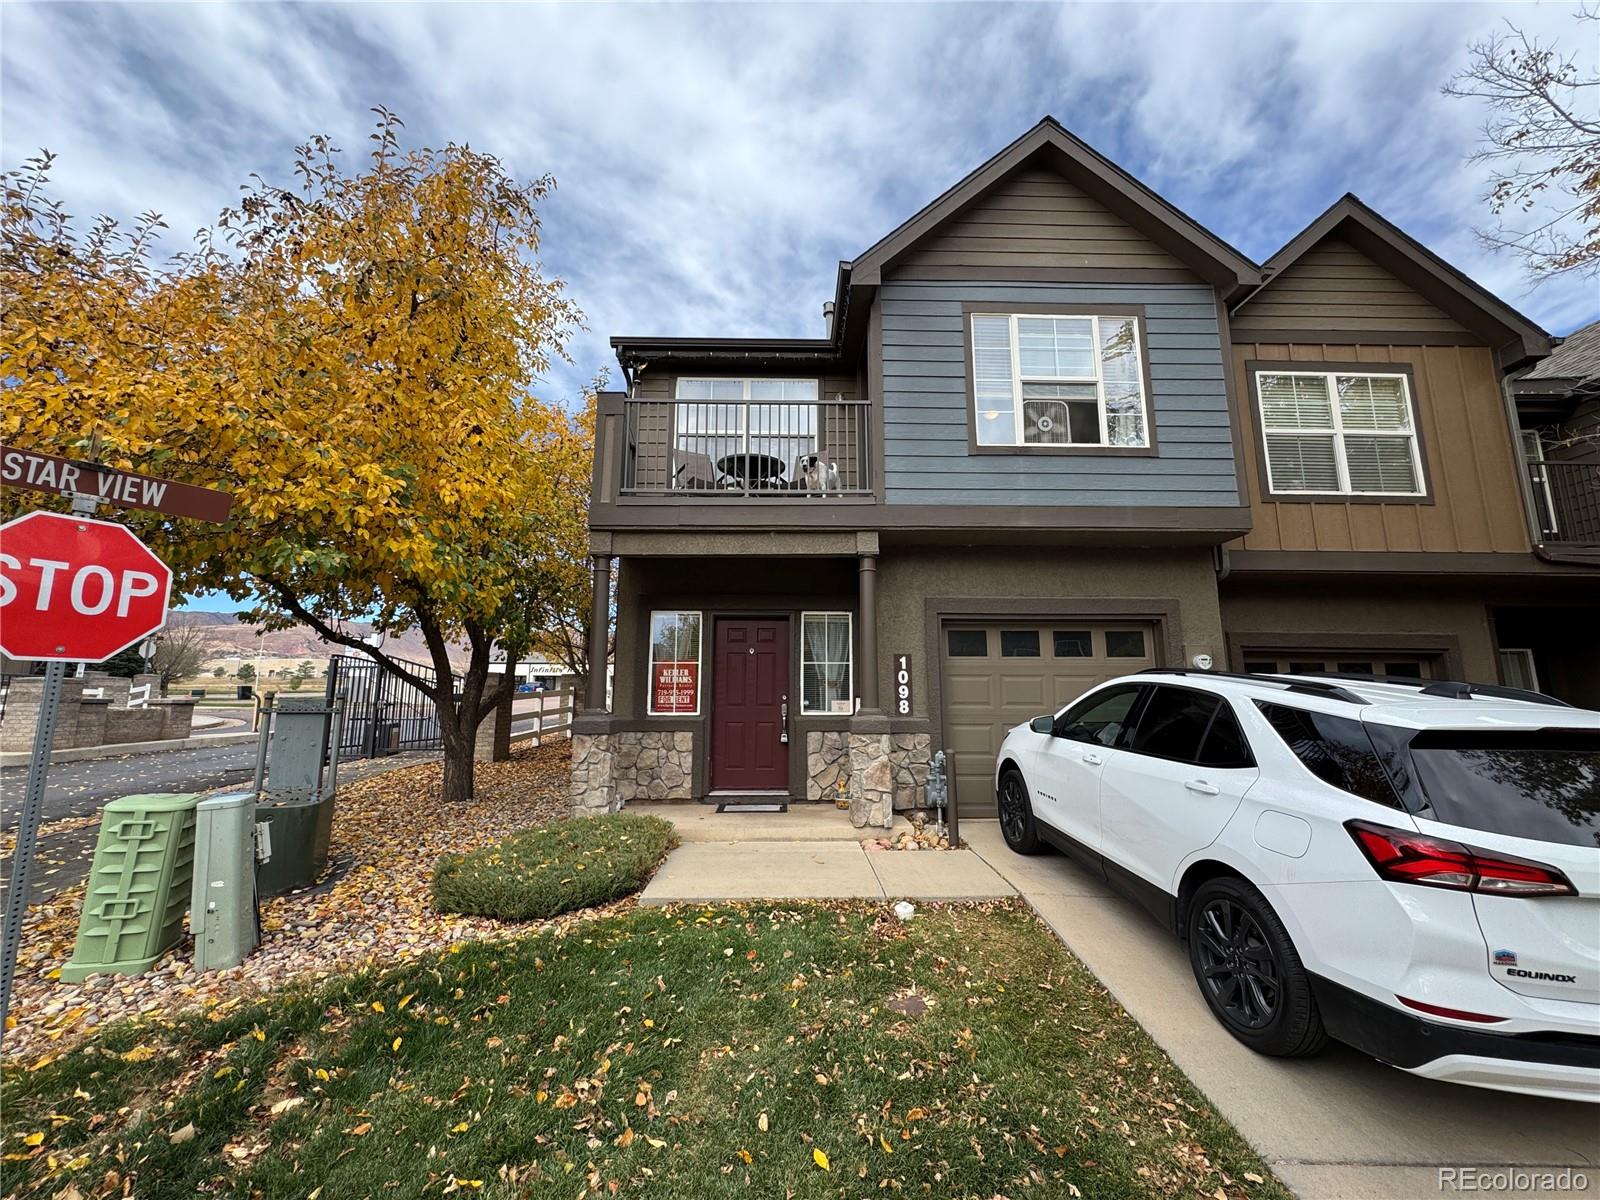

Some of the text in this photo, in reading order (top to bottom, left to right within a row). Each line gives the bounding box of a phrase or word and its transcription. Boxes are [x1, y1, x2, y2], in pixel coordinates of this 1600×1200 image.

[2, 452, 167, 507] STAR VIEW
[0, 553, 159, 618] STOP
[897, 656, 910, 714] 1098
[1506, 968, 1577, 984] EQUINOX
